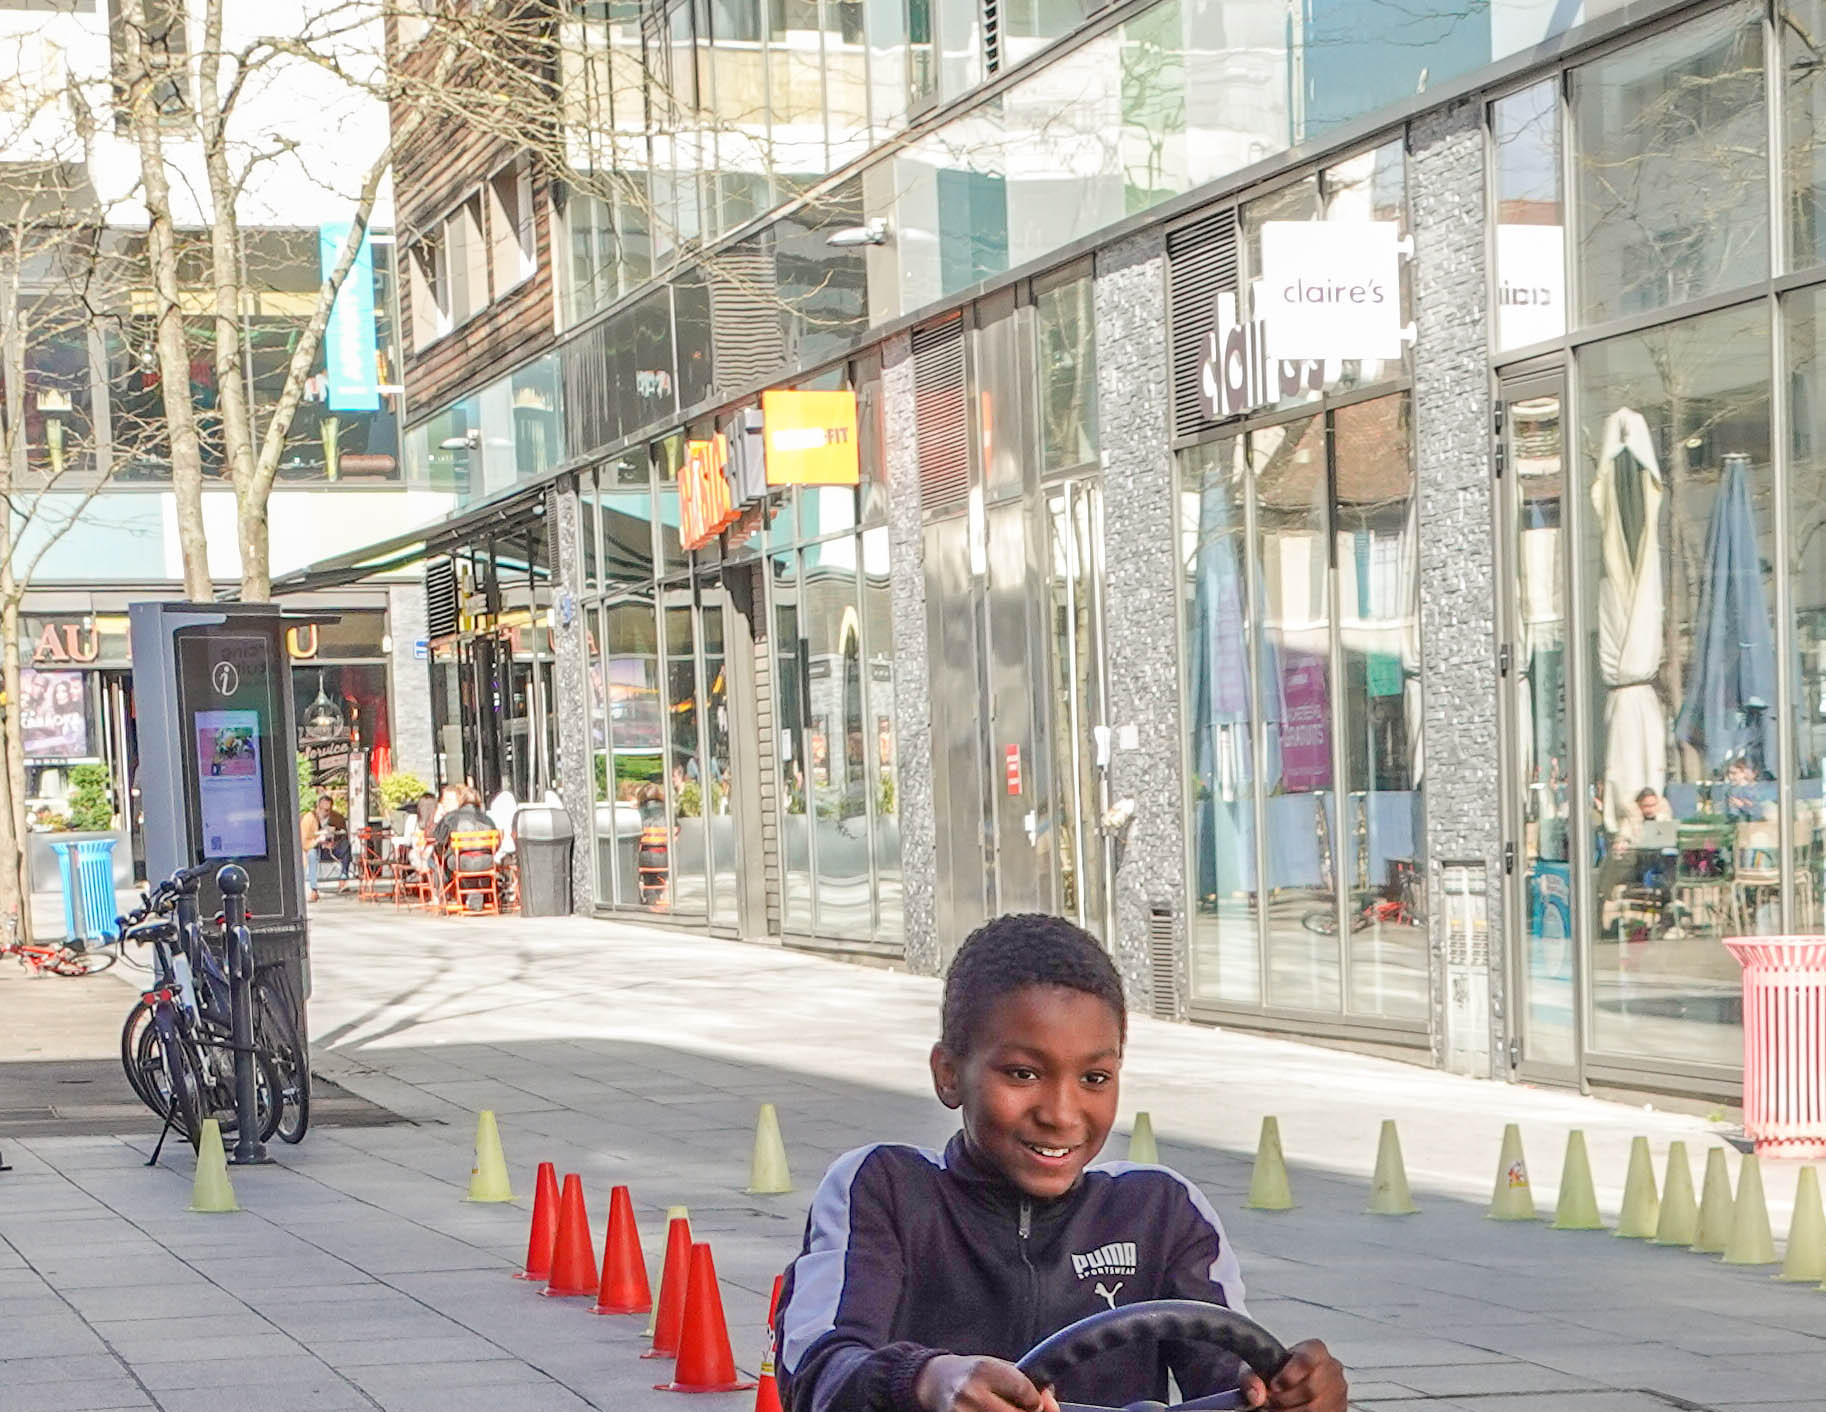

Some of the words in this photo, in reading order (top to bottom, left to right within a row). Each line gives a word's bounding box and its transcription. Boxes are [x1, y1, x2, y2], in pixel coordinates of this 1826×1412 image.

[1283, 278, 1385, 304] claire's
[33, 623, 99, 662] AU
[1072, 1242, 1137, 1273] PUMA
[1077, 1266, 1136, 1279] SPORTSWEAR
